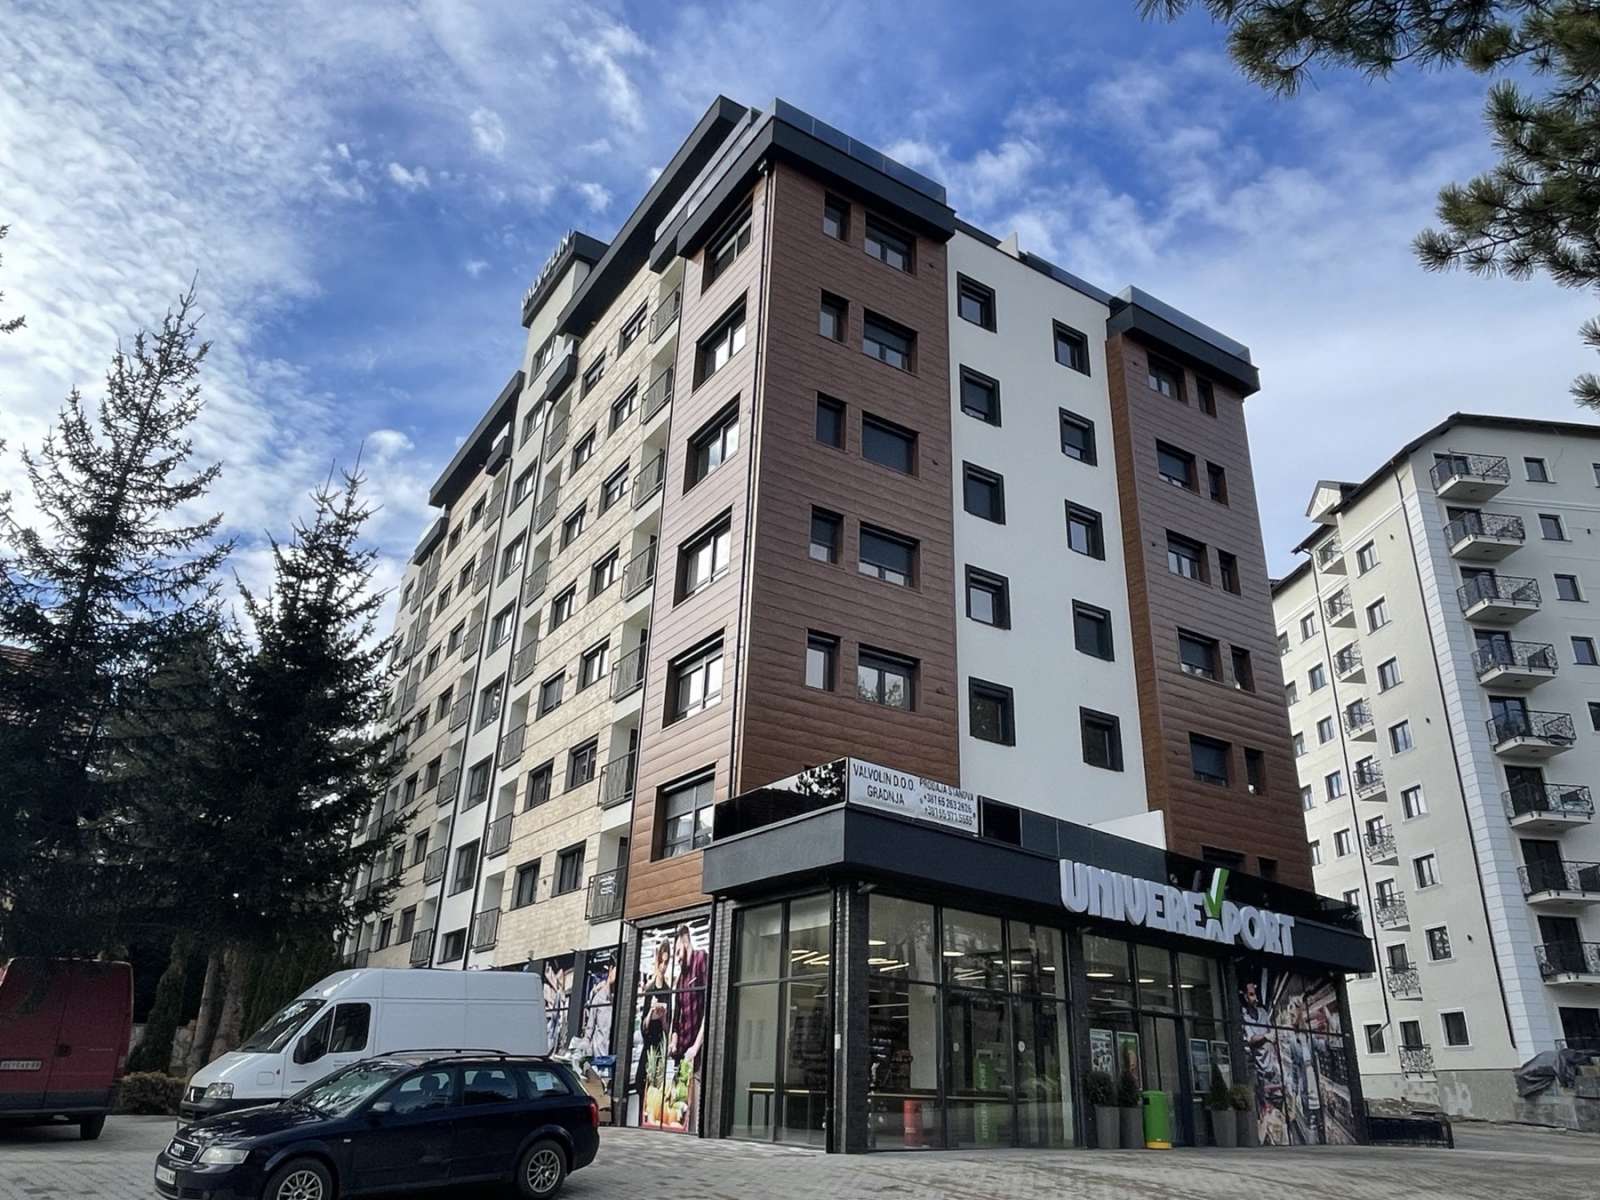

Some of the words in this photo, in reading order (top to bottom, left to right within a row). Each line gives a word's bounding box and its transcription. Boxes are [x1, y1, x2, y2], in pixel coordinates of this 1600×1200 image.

[853, 763, 892, 786] VALVOLIN
[893, 774, 916, 792] D.O.O.
[867, 784, 905, 806] GRADNJA
[1059, 858, 1295, 957] UNIVEREXPORT
